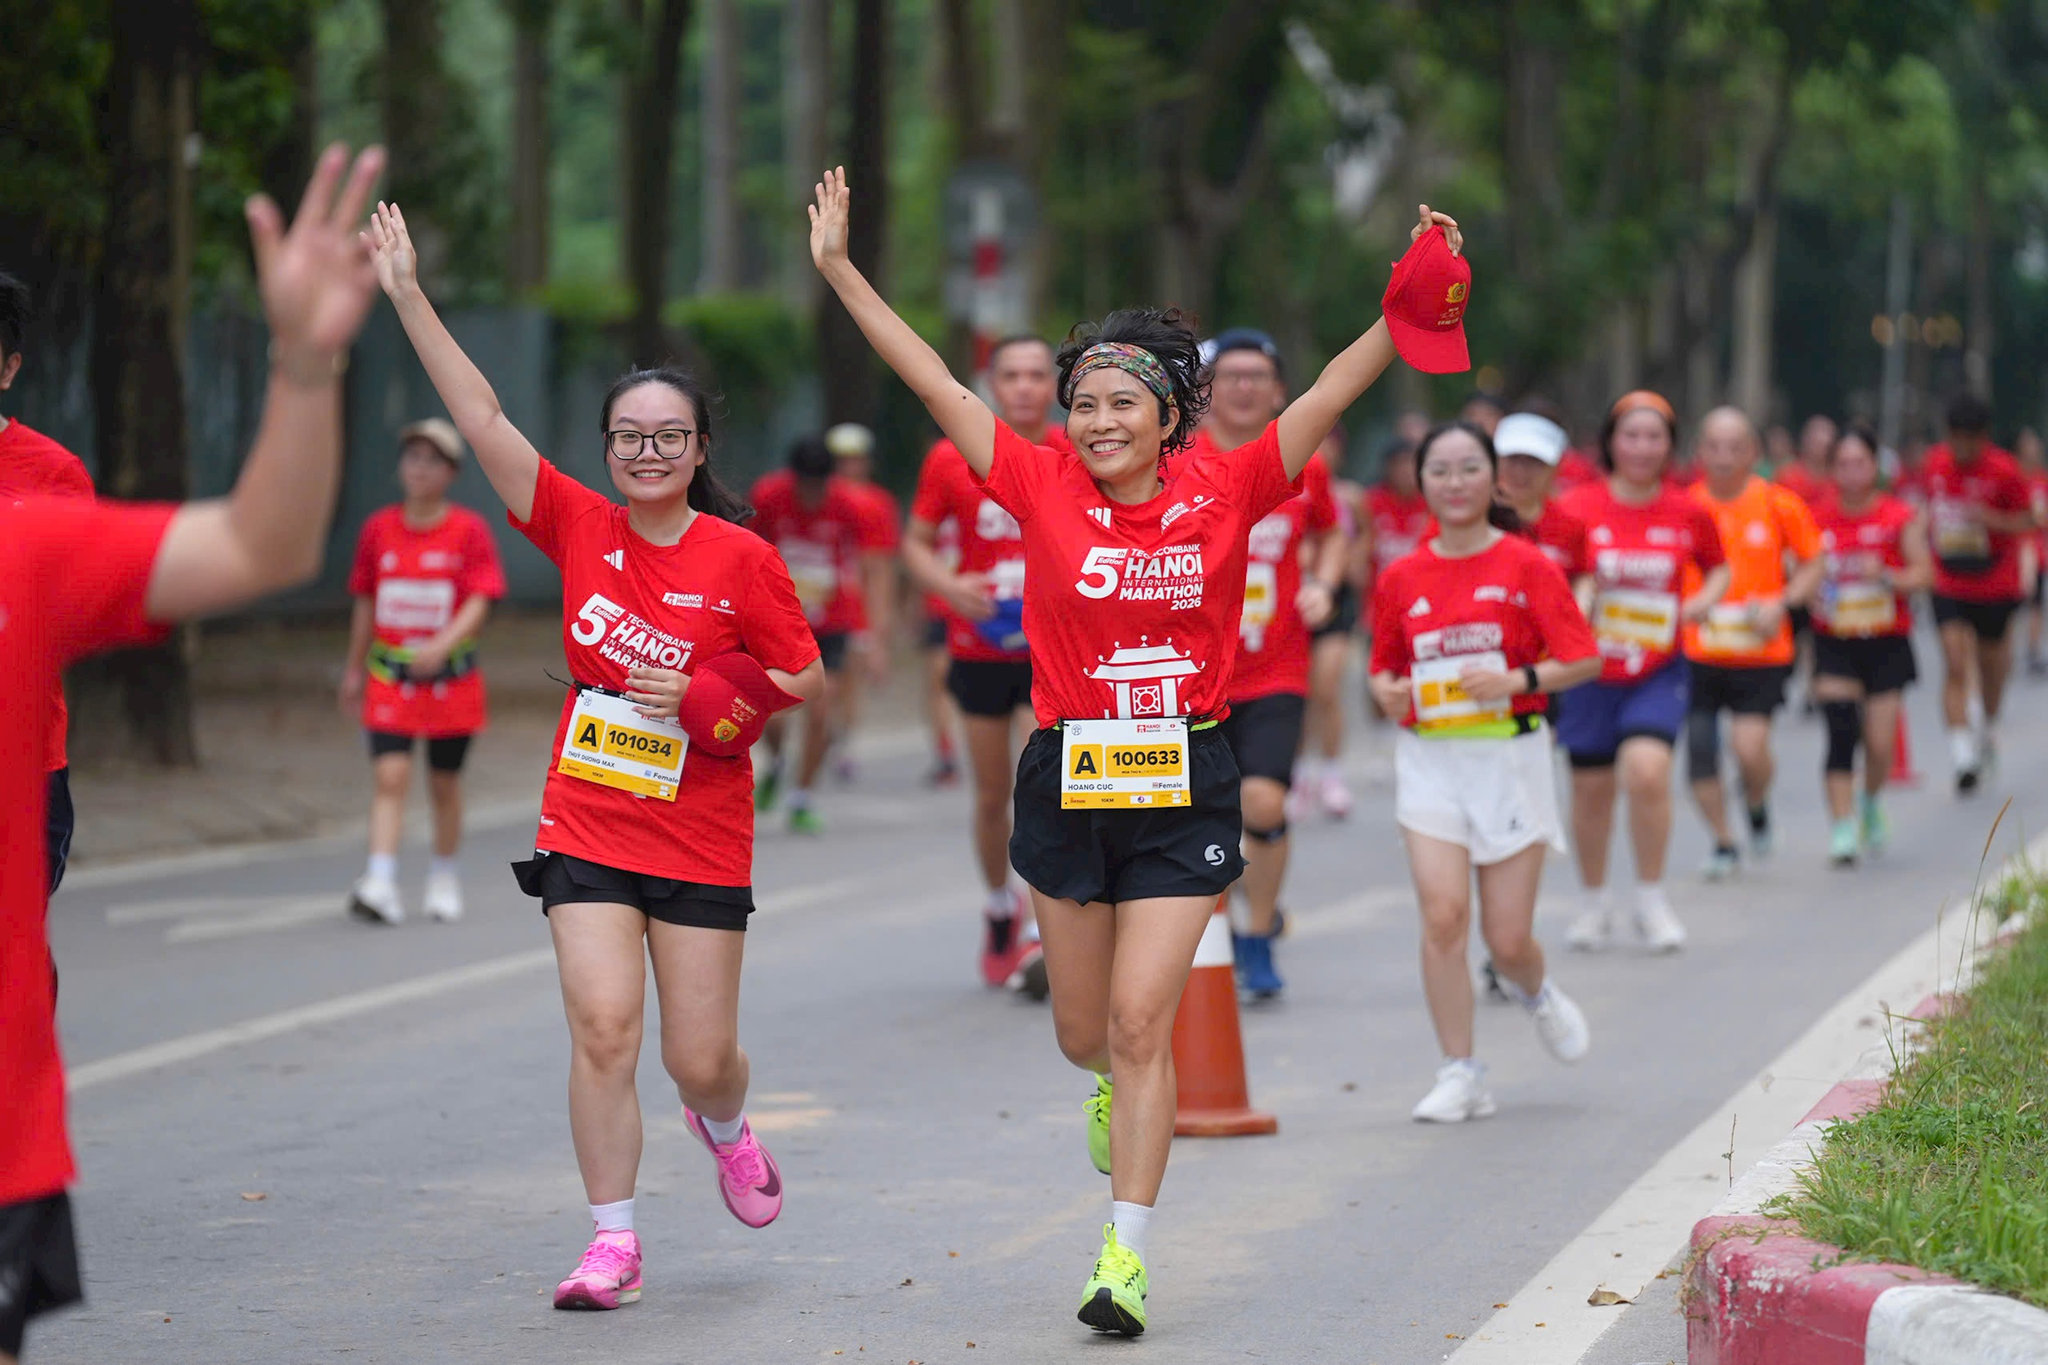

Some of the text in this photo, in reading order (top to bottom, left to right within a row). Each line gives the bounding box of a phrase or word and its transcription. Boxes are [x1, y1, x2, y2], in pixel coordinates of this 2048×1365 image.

[1163, 502, 1185, 519] HANOI
[1131, 544, 1201, 560] TECCOMBANK
[1097, 556, 1124, 566] Edition
[1124, 554, 1204, 579] HANOI
[1074, 546, 1129, 600] 5
[1121, 575, 1205, 587] INTERNATIONAL
[678, 593, 703, 602] HANOI
[1118, 583, 1204, 600] MARATHON
[1170, 597, 1202, 610] 2026
[571, 592, 626, 646] 5
[594, 605, 617, 624] Edition
[626, 613, 695, 650] TECHCOMBANK
[610, 621, 691, 670] HANOI
[579, 722, 597, 747] A
[609, 730, 671, 757] 101034
[601, 760, 615, 768] MAX
[1074, 750, 1180, 774] A 100633
[652, 772, 679, 784] Female
[1068, 783, 1114, 791] HOANG CUC
